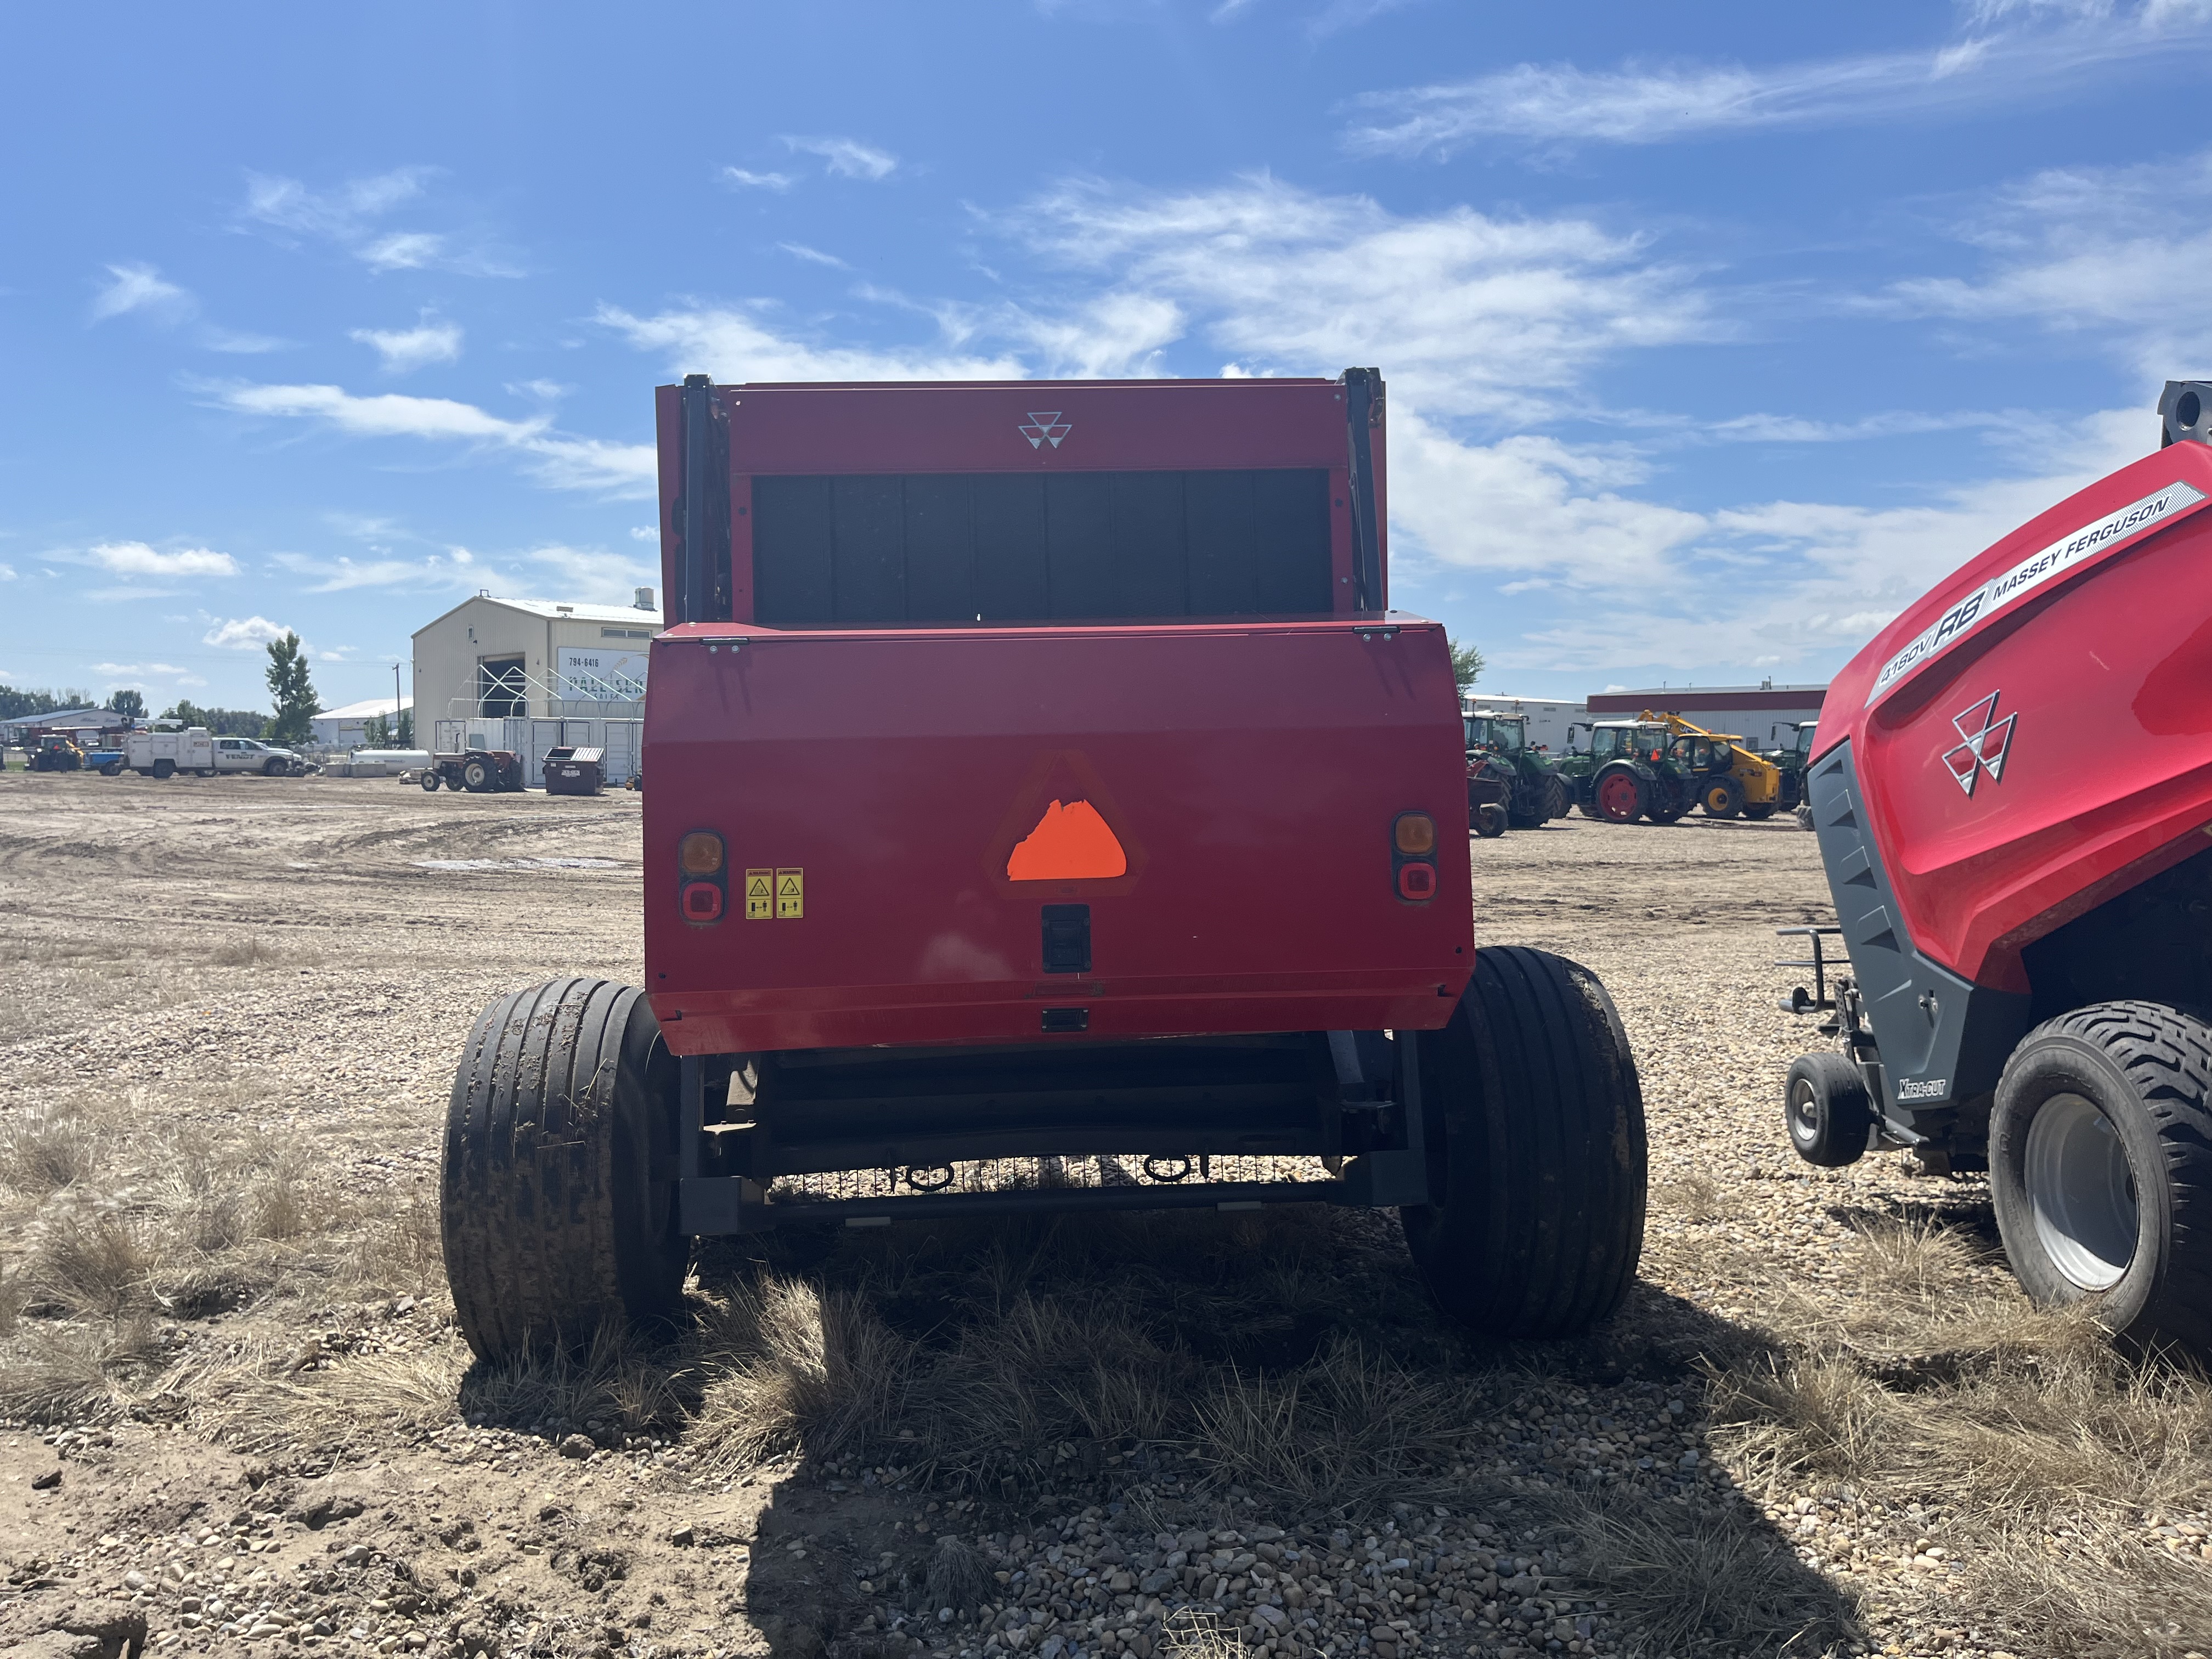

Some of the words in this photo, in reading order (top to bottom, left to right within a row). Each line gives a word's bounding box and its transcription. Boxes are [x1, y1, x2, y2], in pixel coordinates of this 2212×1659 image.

[1880, 631, 1933, 684] 4180V
[1932, 589, 1987, 648] RB
[1993, 549, 2062, 601] MASSEY
[2064, 495, 2170, 559] FERGUSON
[569, 657, 599, 668] 794-6416
